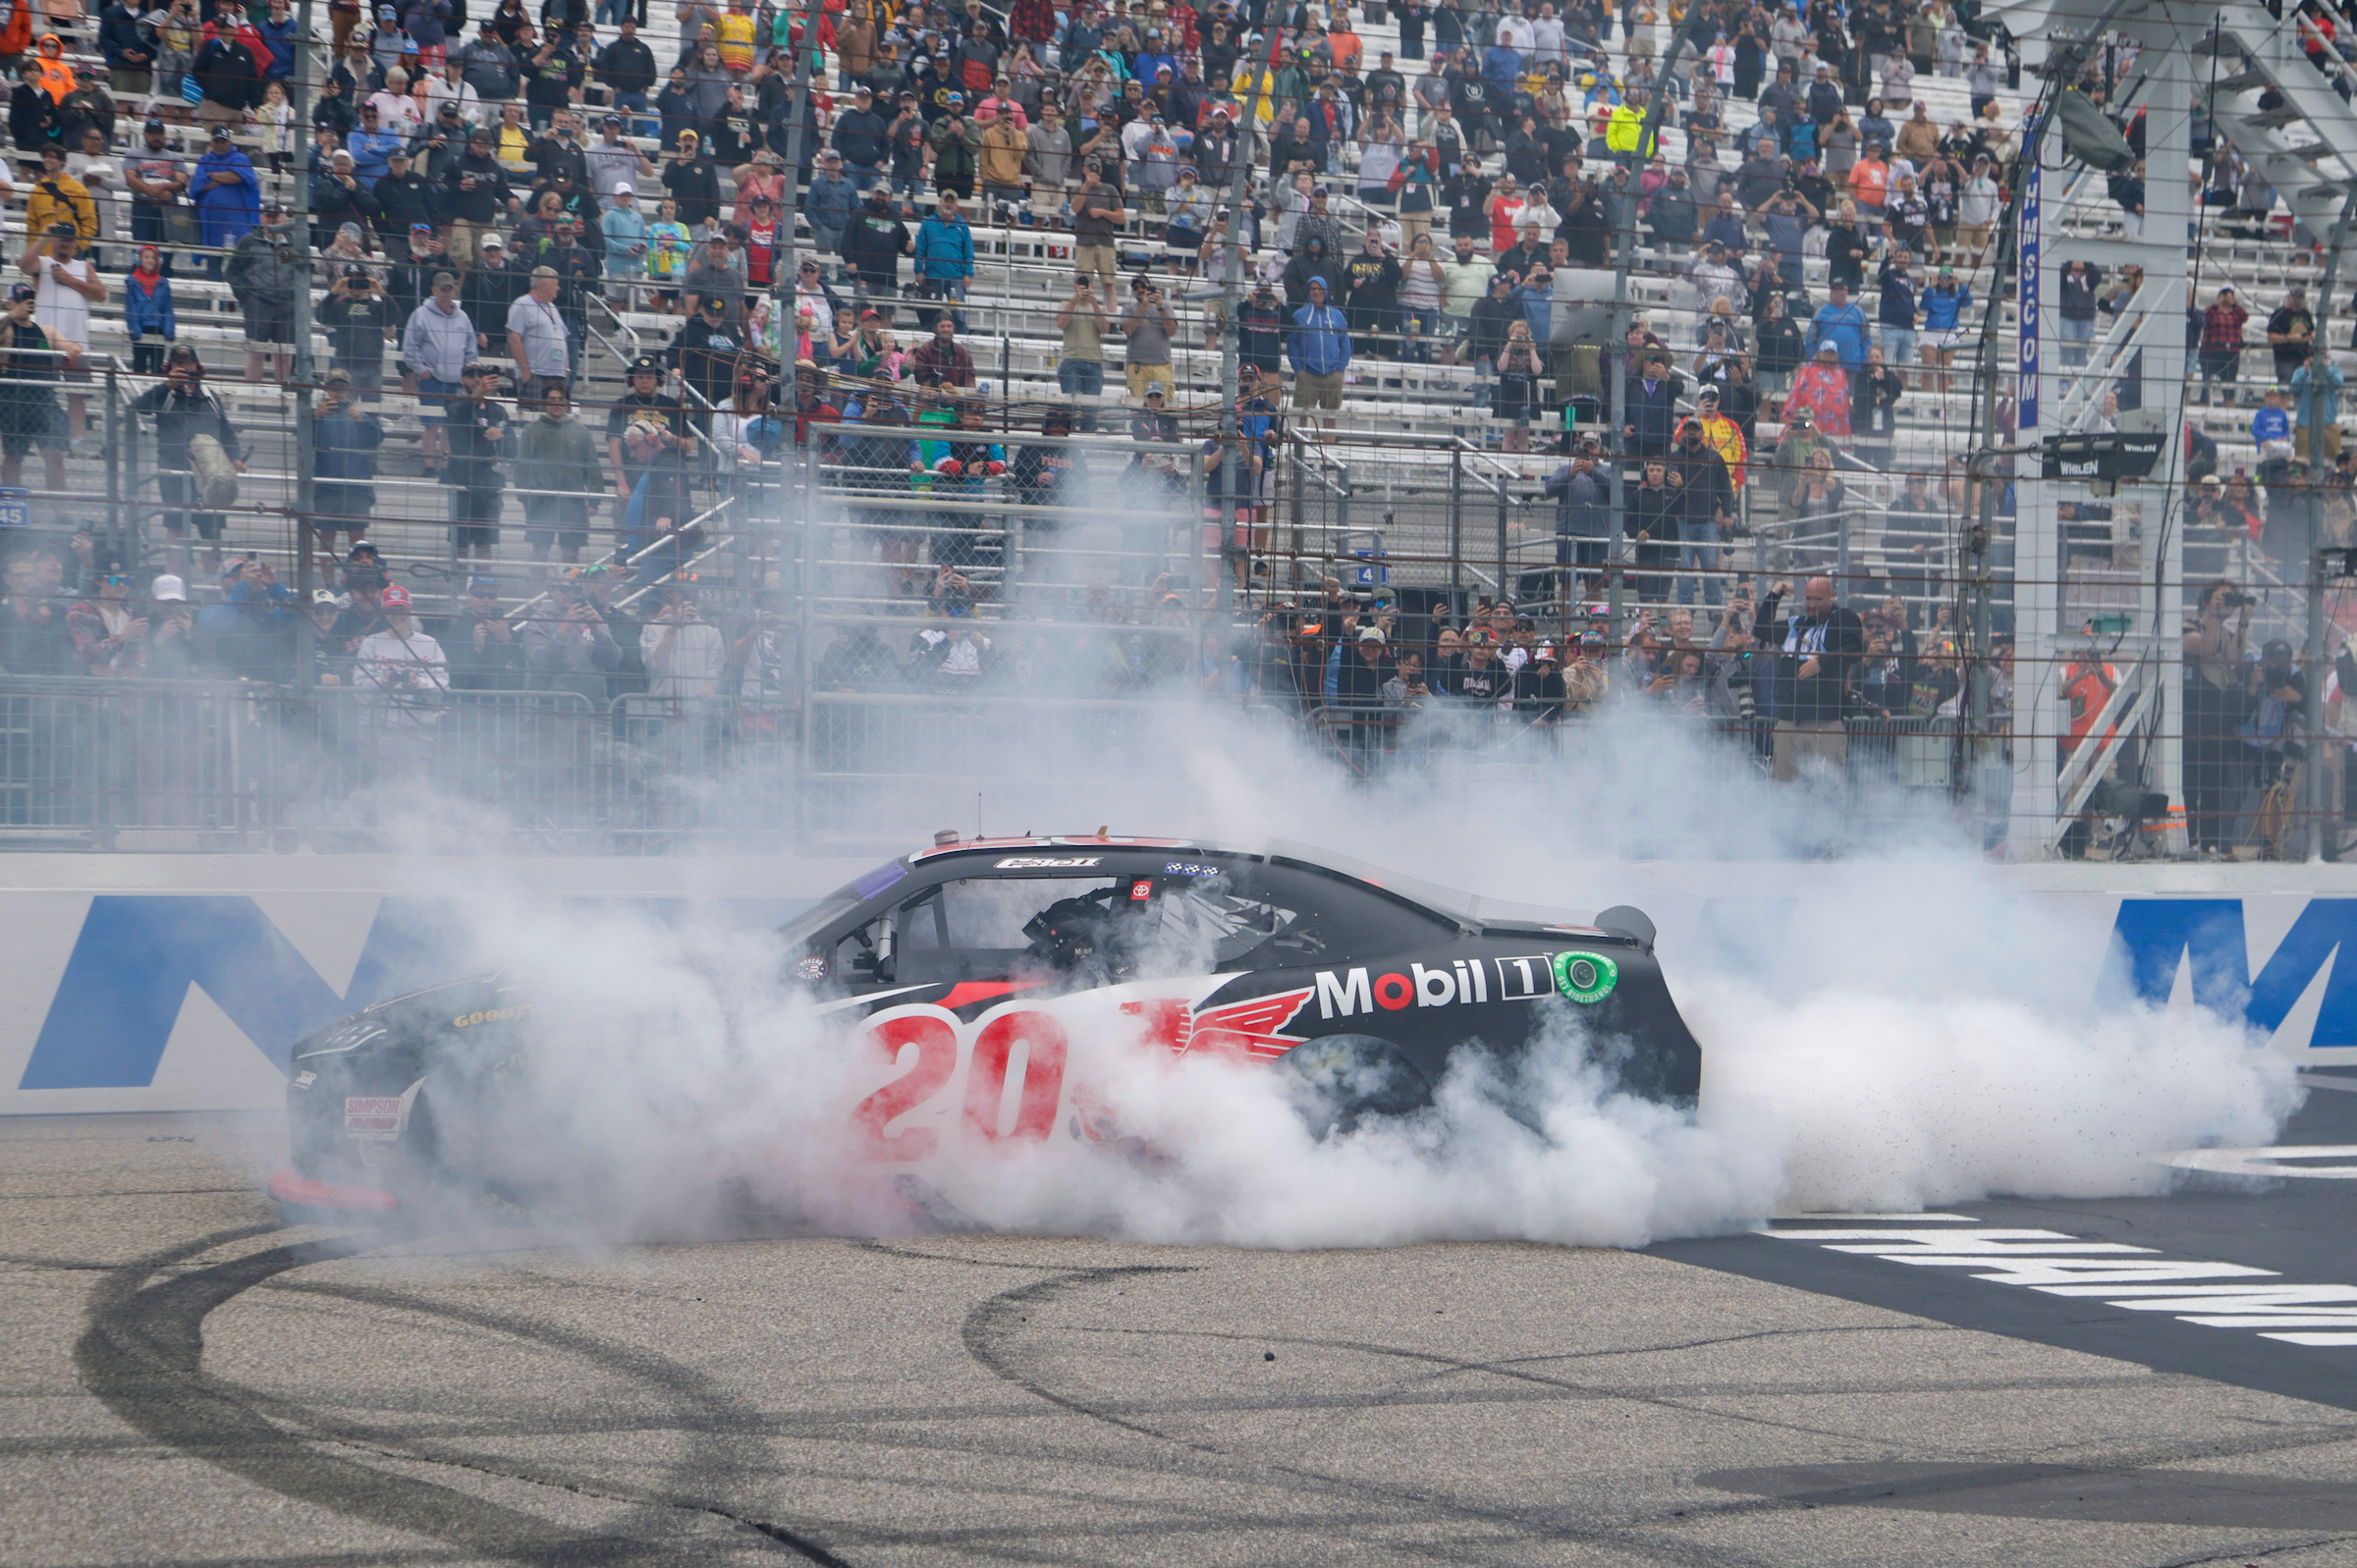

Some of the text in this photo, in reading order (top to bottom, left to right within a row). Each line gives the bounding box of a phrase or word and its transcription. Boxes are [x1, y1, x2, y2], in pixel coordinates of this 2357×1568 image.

[2019, 161, 2039, 403] HMS.COM
[796, 970, 824, 980] SALUTES
[798, 958, 824, 967] NASCAR
[1314, 958, 1488, 1019] Mobil
[1557, 976, 1613, 1002] GET BIOETHANOL
[848, 1015, 1069, 1162] 20
[346, 1099, 400, 1114] SIMPSON
